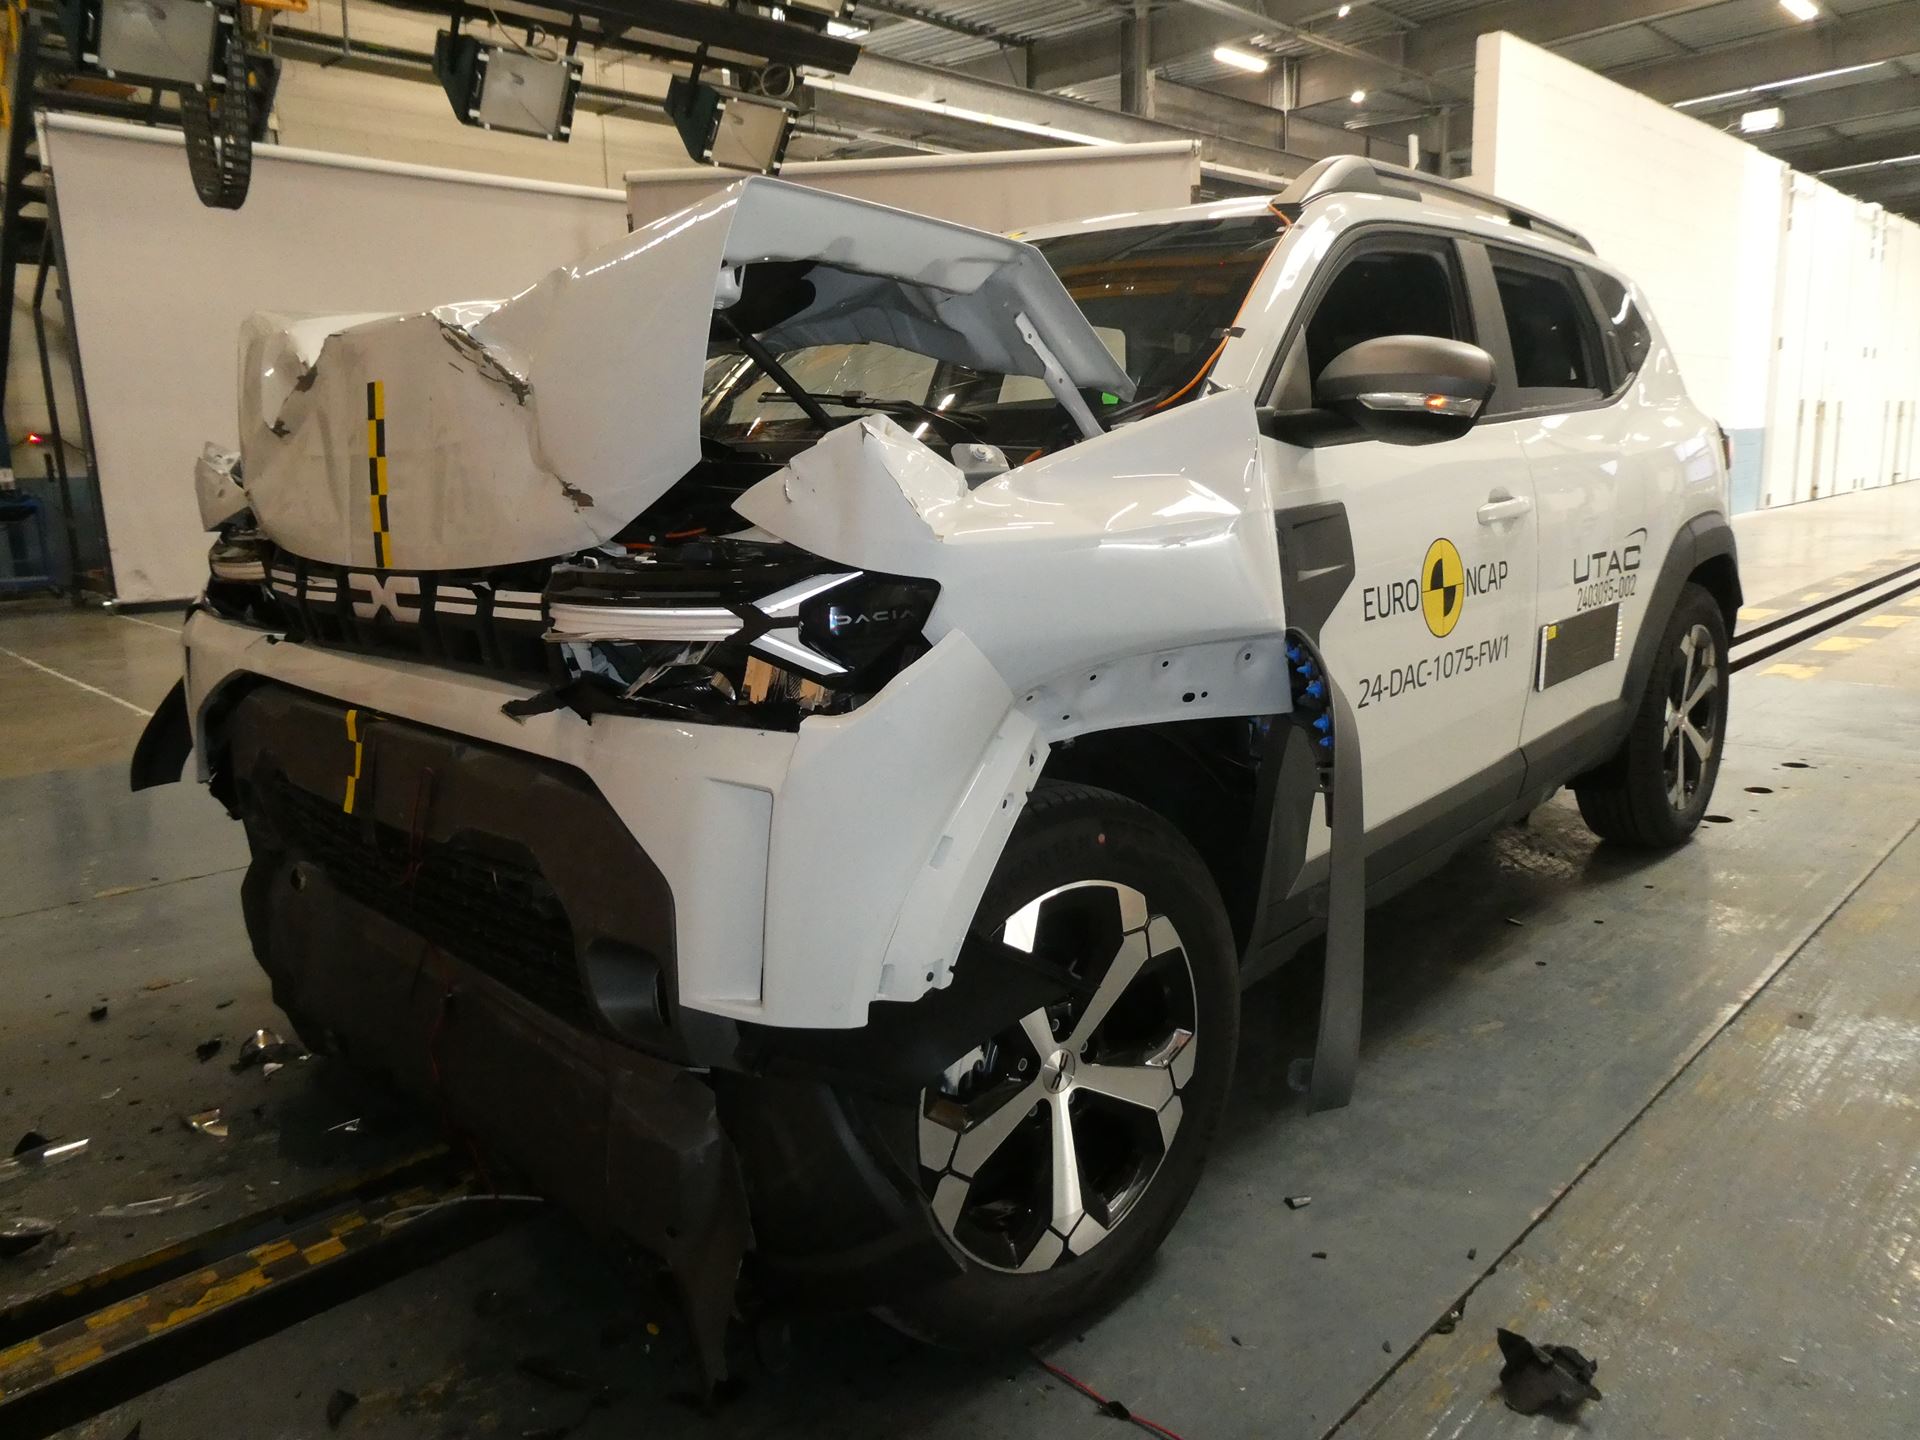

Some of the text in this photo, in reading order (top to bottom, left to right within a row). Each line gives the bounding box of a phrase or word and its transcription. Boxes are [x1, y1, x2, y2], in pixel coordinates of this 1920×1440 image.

[1573, 545, 1641, 585] UTAC
[1363, 560, 1508, 622] EURO NCAP
[834, 609, 914, 626] DACIA
[1357, 634, 1510, 709] 24-DAC-1075-FW1
